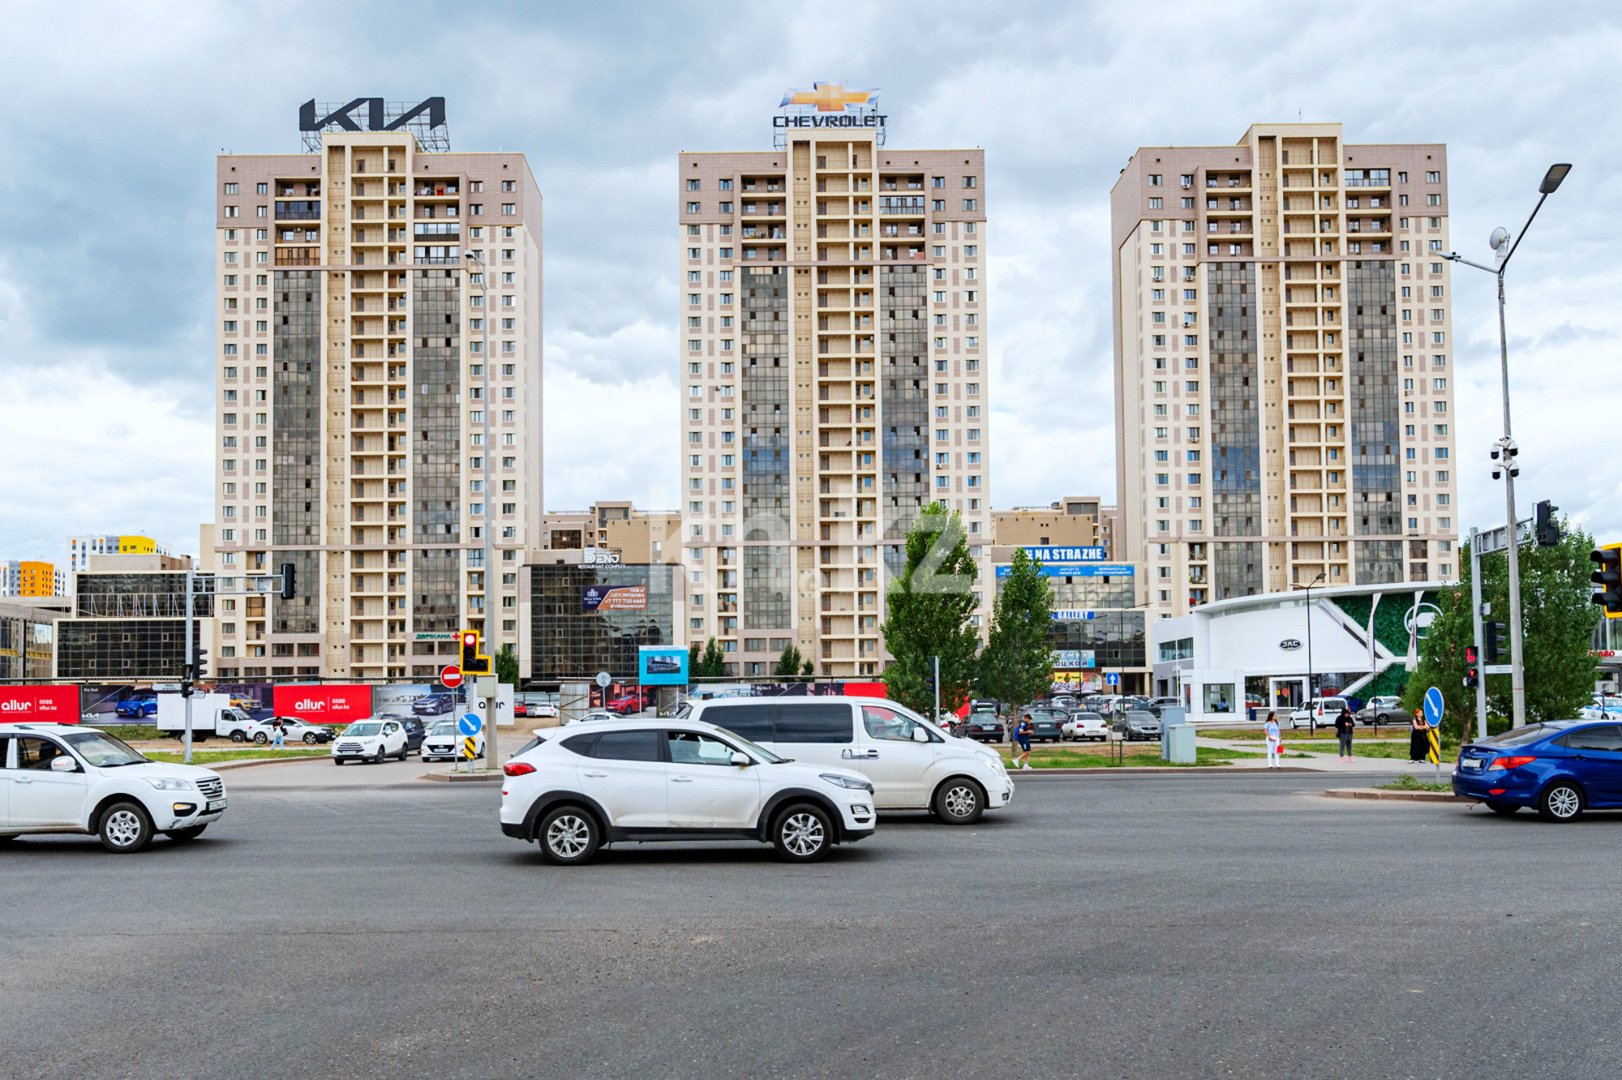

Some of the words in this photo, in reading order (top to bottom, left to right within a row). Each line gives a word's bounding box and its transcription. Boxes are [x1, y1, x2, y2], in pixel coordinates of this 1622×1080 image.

[300, 97, 445, 131] KIA
[773, 115, 888, 127] CHEVROLET
[1035, 548, 1050, 560] NA
[1052, 548, 1102, 560] STRAZHE
[1058, 611, 1088, 620] GALLERY
[1, 699, 31, 711] allur
[295, 698, 325, 710] allur
